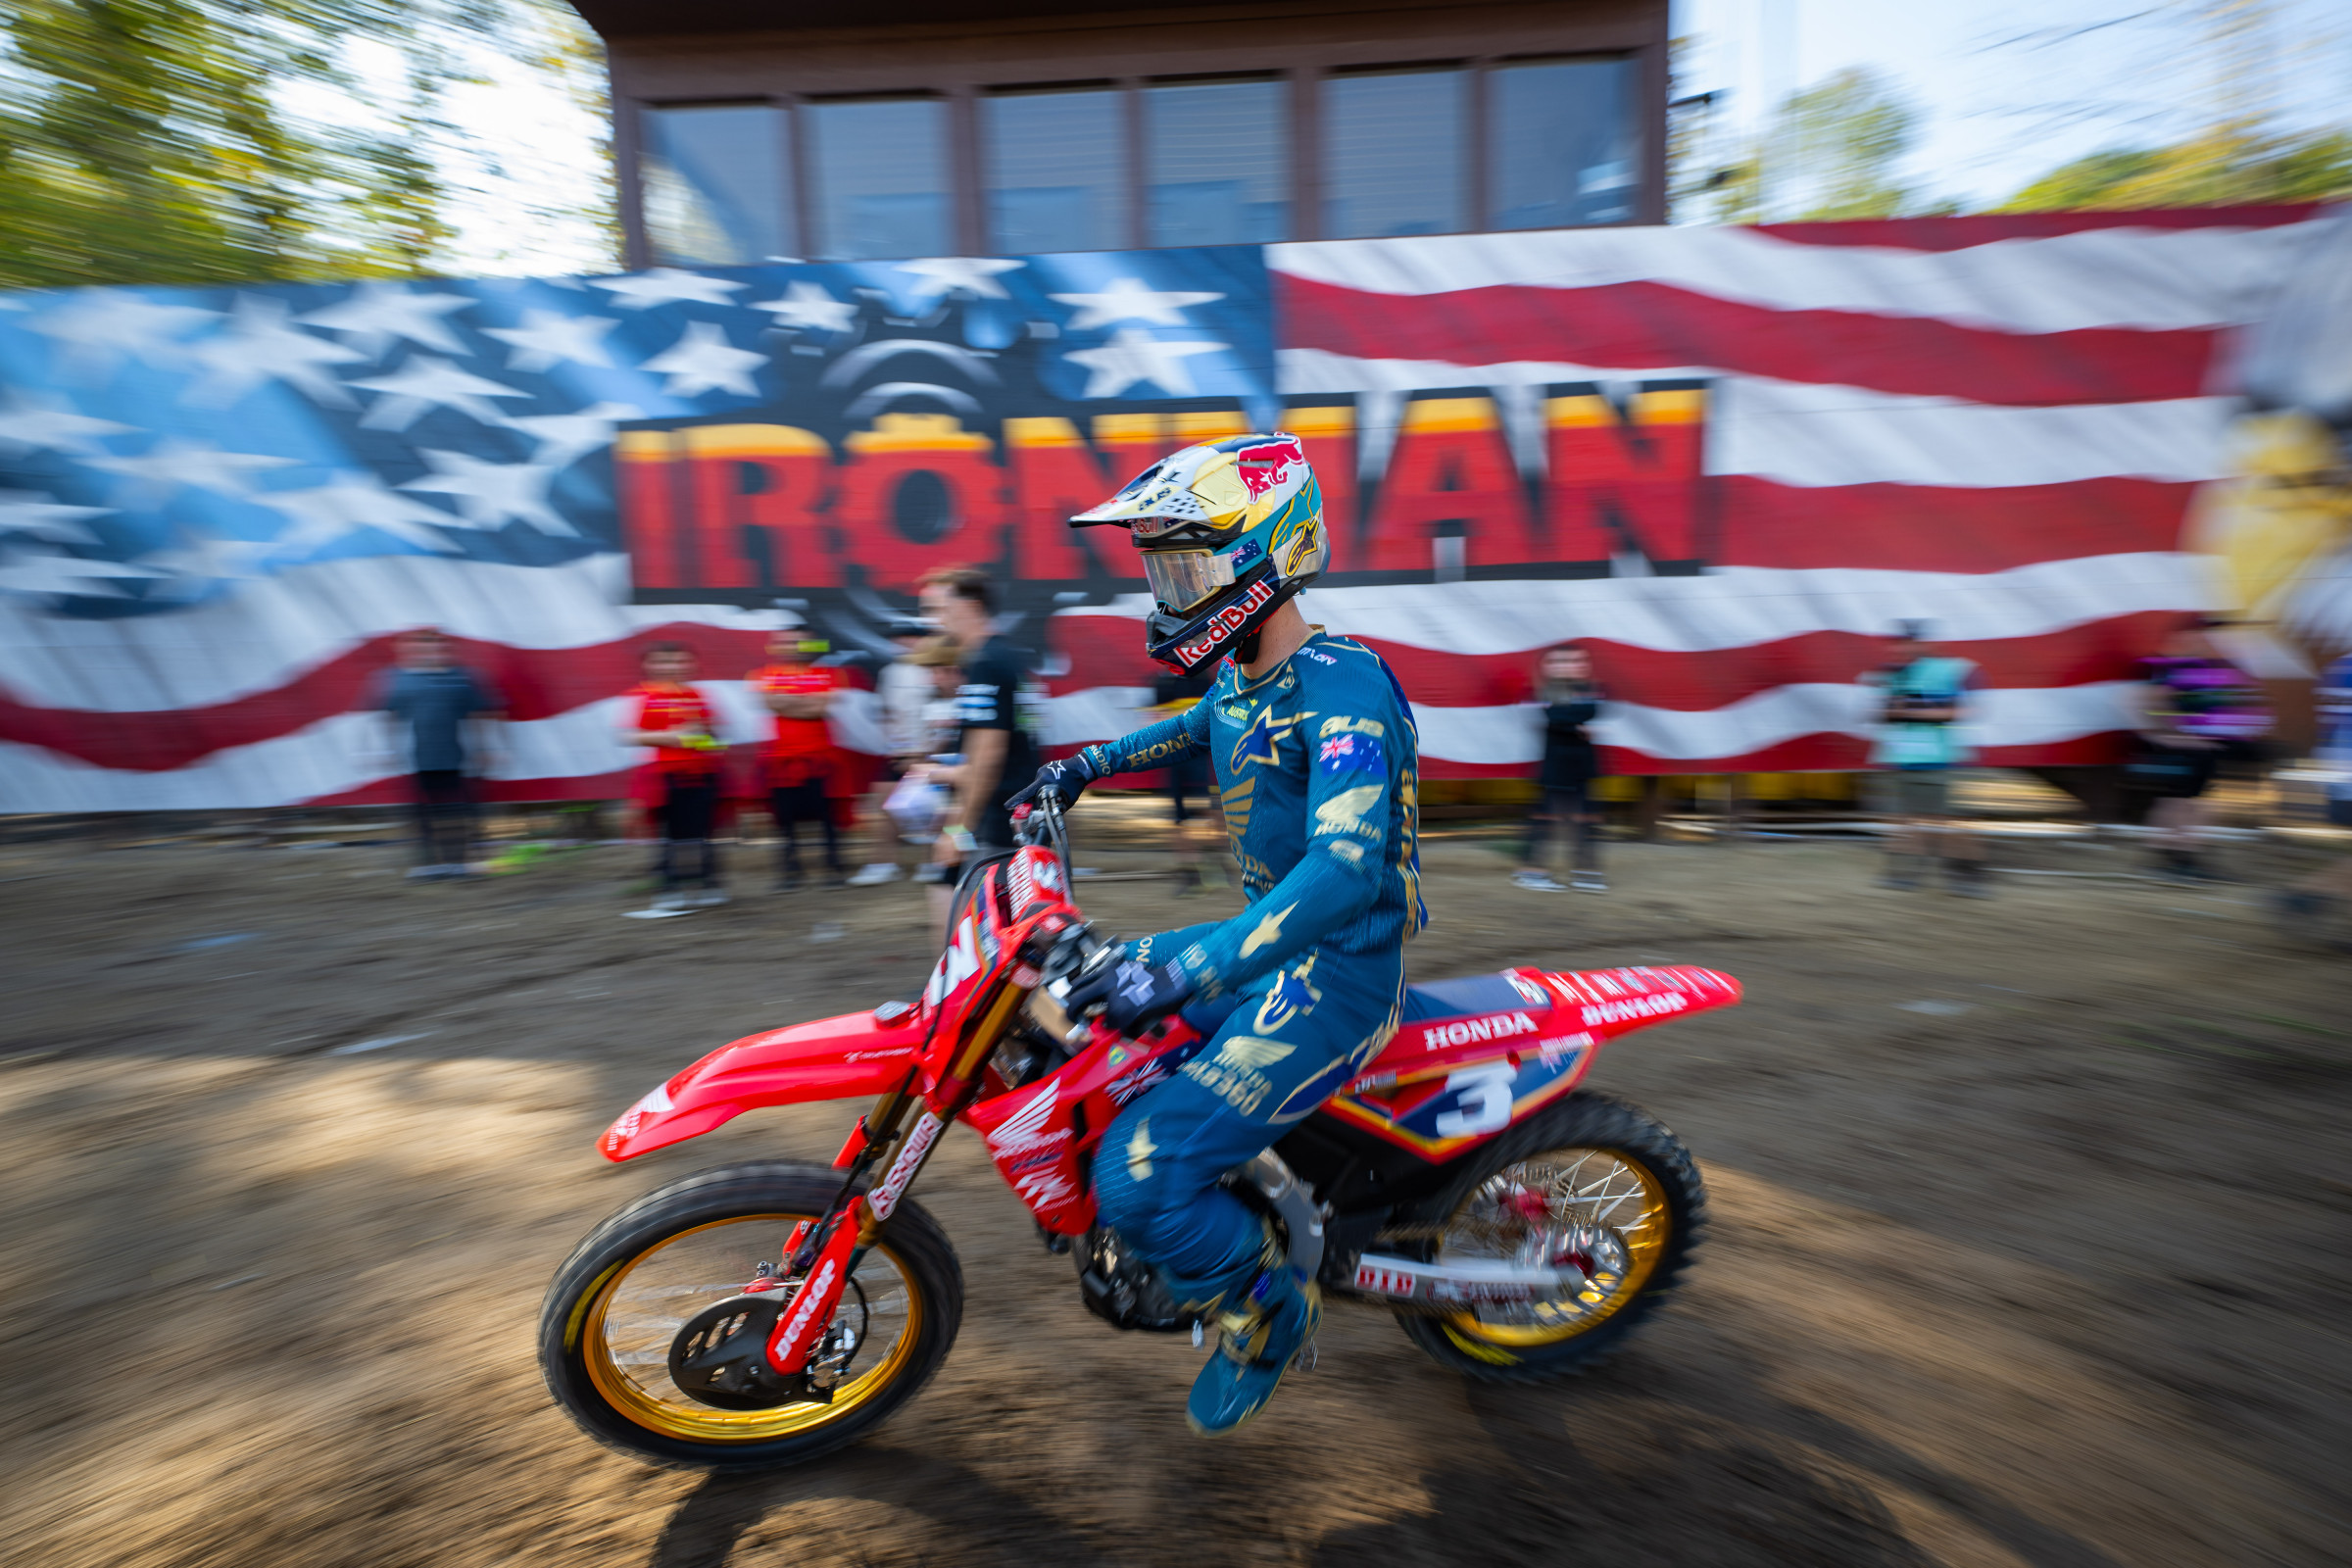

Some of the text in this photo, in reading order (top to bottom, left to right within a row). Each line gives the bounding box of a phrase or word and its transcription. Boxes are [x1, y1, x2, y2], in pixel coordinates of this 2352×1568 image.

[1126, 732, 1196, 768] HON
[1423, 1010, 1540, 1052] HONDA
[1435, 1059, 1518, 1139] 3
[774, 1258, 835, 1361] DUNLOP
